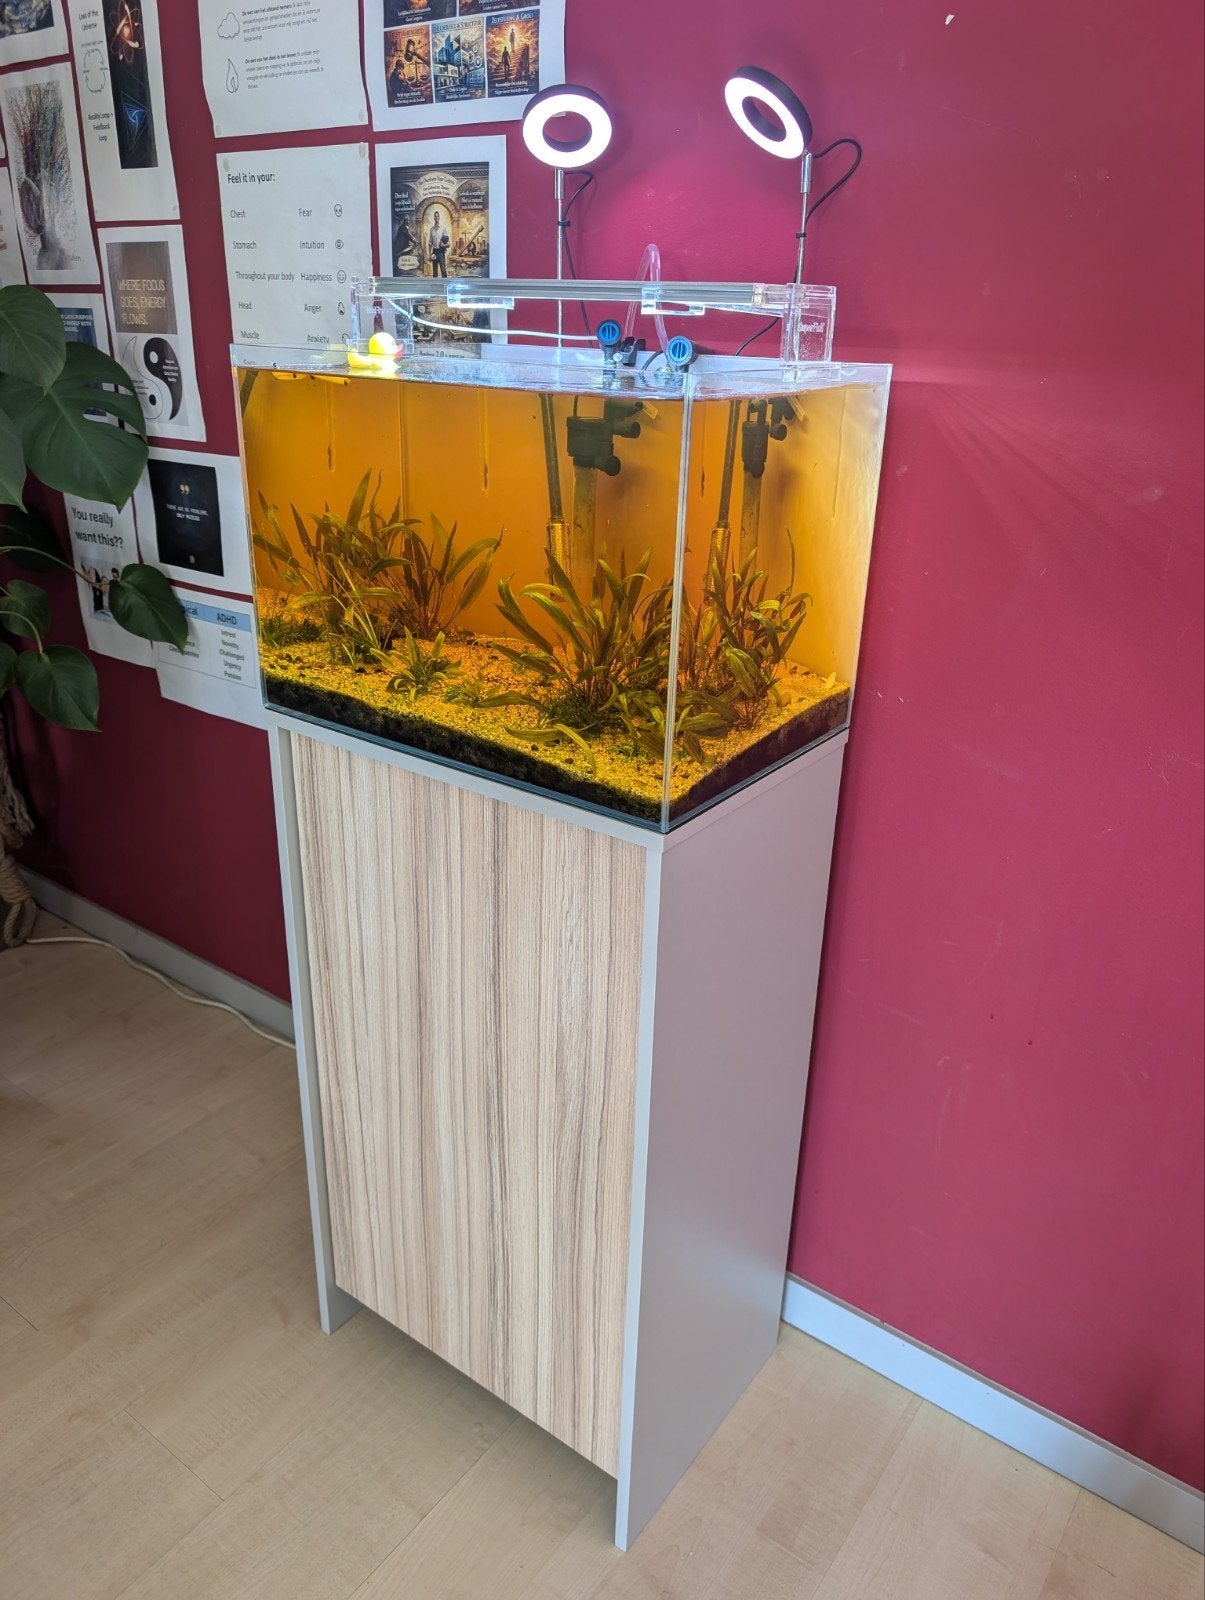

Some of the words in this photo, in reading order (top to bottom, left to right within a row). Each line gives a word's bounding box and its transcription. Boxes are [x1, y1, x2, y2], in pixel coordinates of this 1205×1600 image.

[228, 173, 242, 184] Feel
[242, 173, 248, 183] it
[249, 172, 256, 182] in
[257, 173, 276, 186] your:
[230, 209, 245, 218] Chest
[299, 208, 312, 217] Fear
[233, 241, 257, 250] Stomach
[300, 241, 324, 249] Intuition
[235, 271, 266, 281] Throughout
[267, 273, 280, 281] your
[281, 271, 294, 281] body
[301, 272, 332, 282] Happiness
[118, 279, 141, 291] WHERE
[142, 279, 165, 291] FOCUS
[120, 297, 140, 310] GOES,
[141, 297, 166, 308] ENERGY
[304, 304, 322, 313] Anger
[122, 314, 148, 325] FLOWS.
[241, 331, 260, 339] Muscle
[307, 335, 330, 343] Anxiety
[71, 507, 87, 521] You
[89, 512, 113, 528] really
[76, 531, 99, 544] want
[99, 533, 123, 548] this??
[217, 612, 237, 625] ADHD
